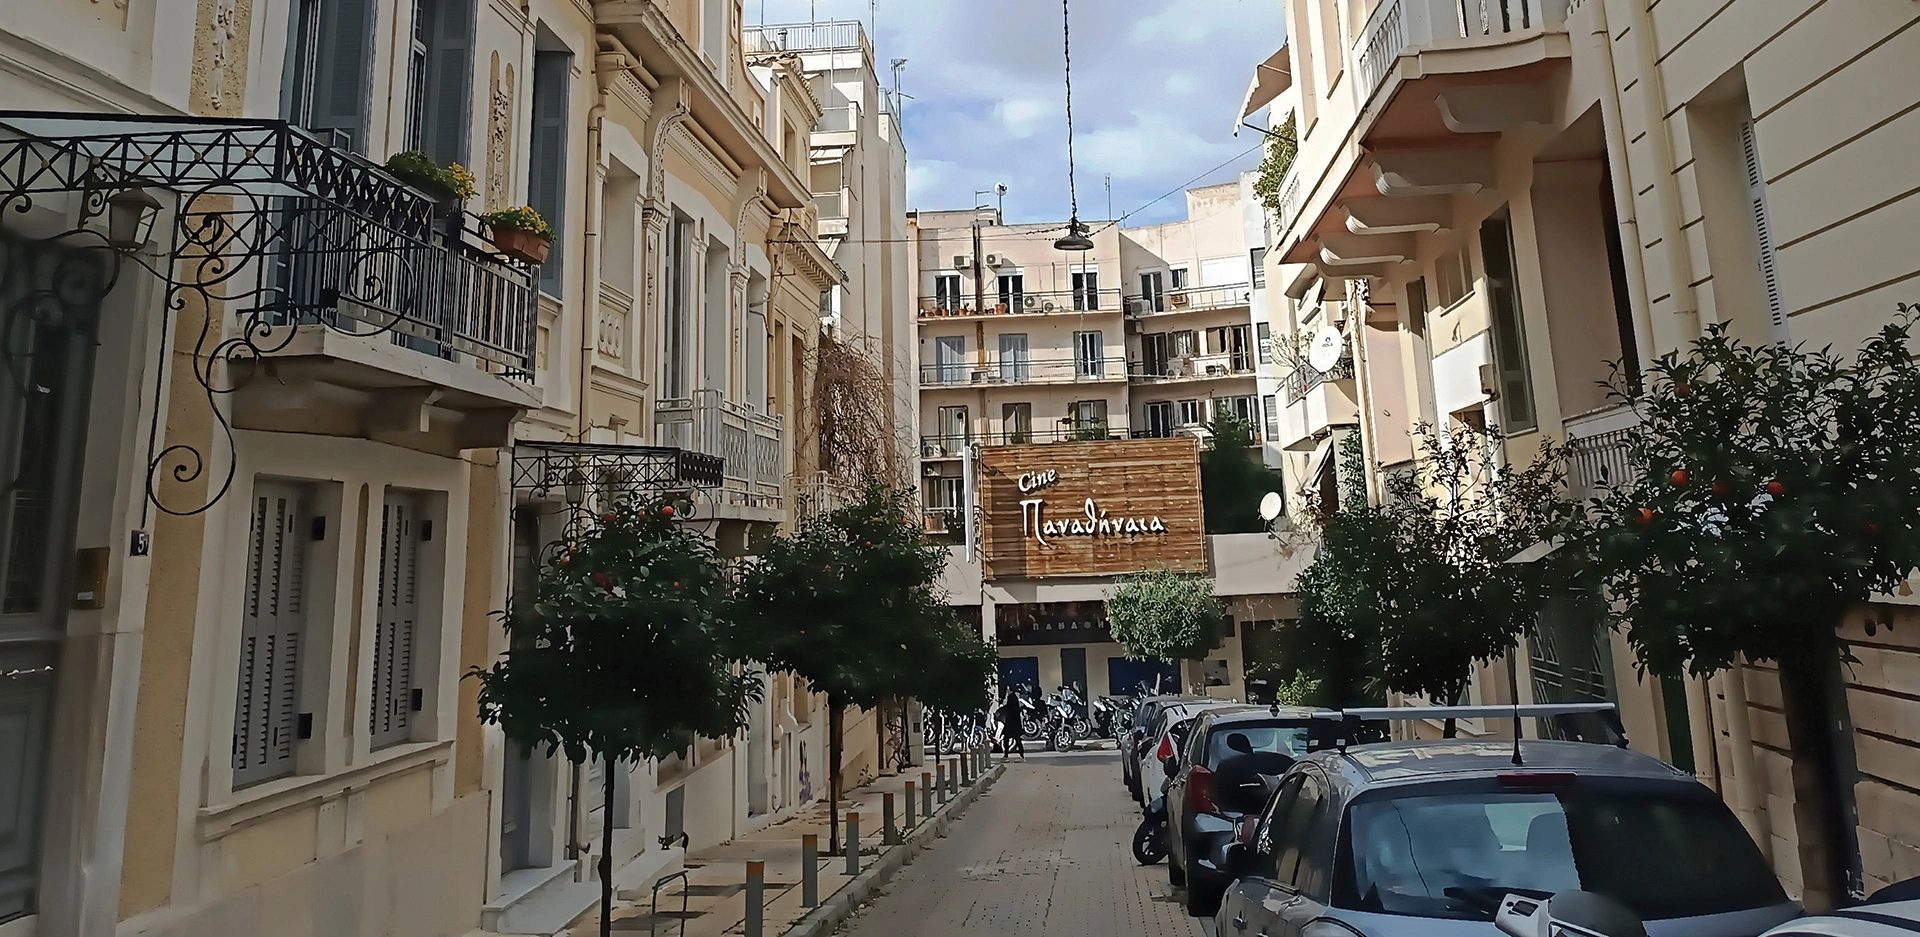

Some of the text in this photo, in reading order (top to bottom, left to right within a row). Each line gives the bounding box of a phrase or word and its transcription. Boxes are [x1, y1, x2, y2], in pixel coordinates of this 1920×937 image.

[1018, 468, 1056, 493] Cine
[1019, 497, 1165, 546] Παναθήναια
[1032, 621, 1104, 631] ΠΑΝΑΘΗ
